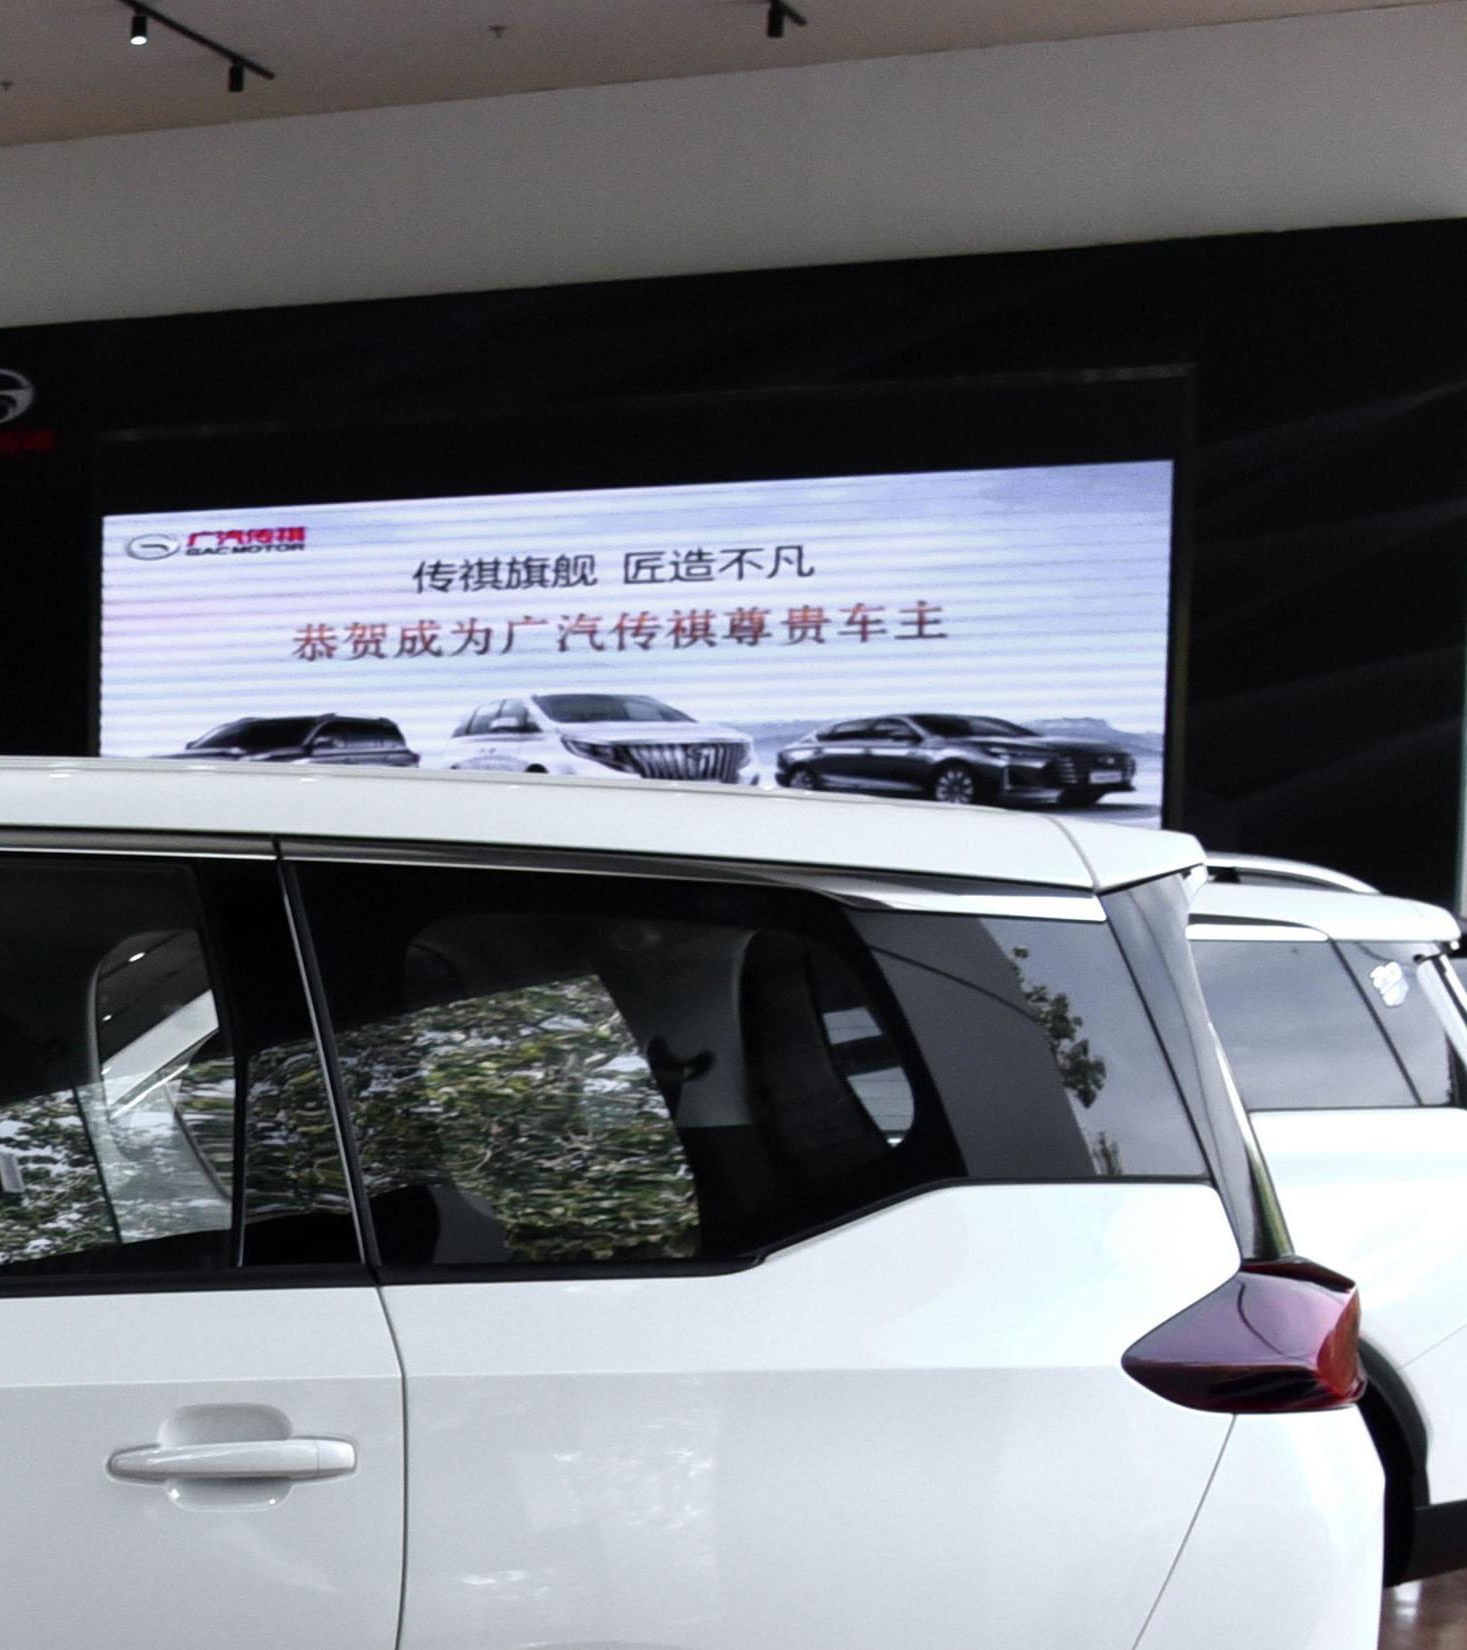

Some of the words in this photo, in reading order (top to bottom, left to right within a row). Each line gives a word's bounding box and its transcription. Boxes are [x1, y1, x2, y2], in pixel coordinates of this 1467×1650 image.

[412, 553, 598, 593] 传祺旗舰
[622, 545, 815, 585] 匠造不凡
[291, 600, 950, 662] 恭贺成为广汽传祺尊贵车主
